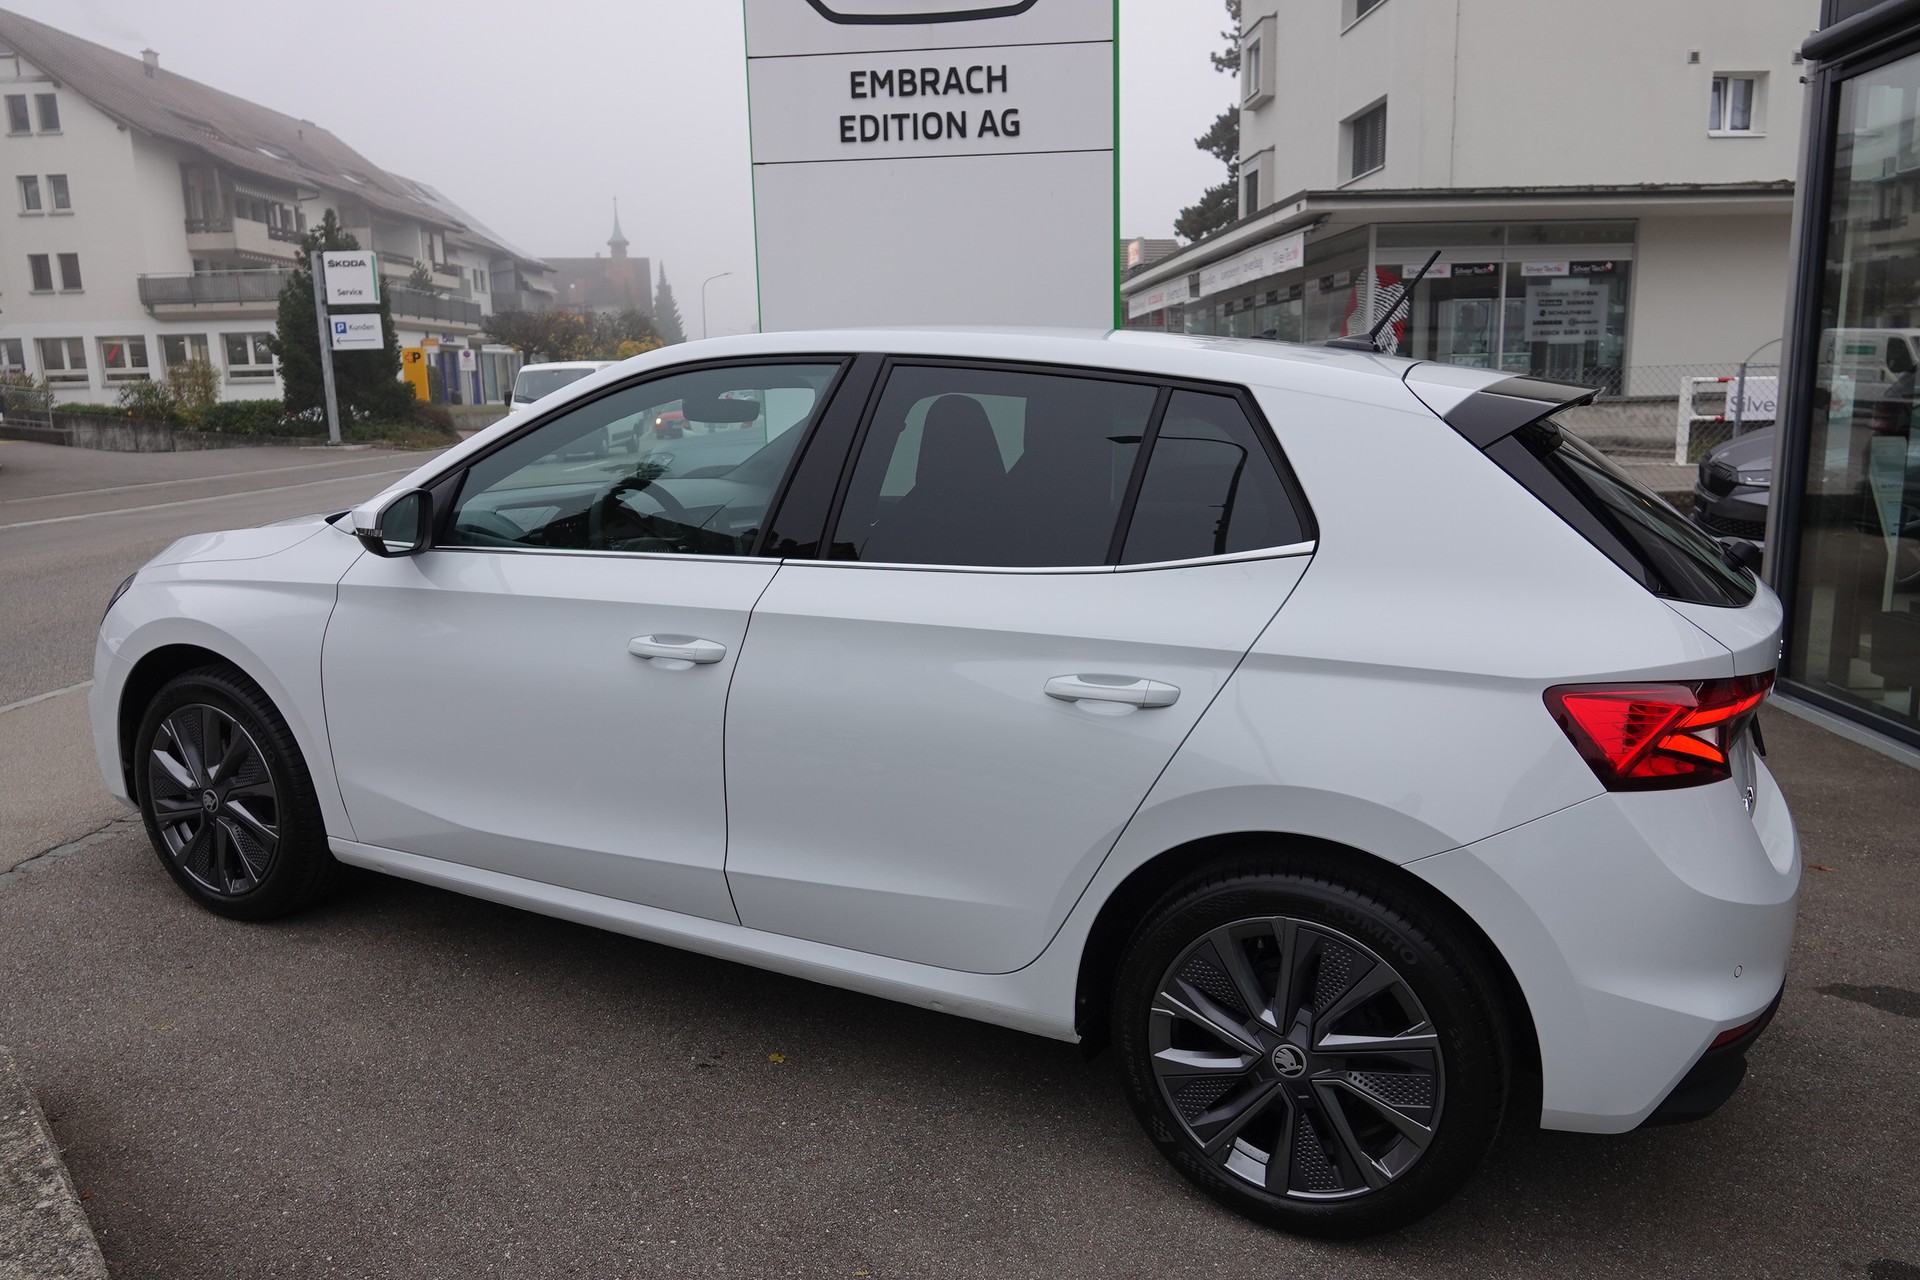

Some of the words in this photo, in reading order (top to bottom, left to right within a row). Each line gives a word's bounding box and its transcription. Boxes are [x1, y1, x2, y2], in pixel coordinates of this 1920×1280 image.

[850, 65, 1008, 99] EMBRACH
[840, 110, 967, 143] EDITION
[977, 108, 1020, 138] AG
[337, 288, 363, 296] Service
[348, 323, 375, 331] Kunden
[1324, 902, 1418, 966] KUMHO
